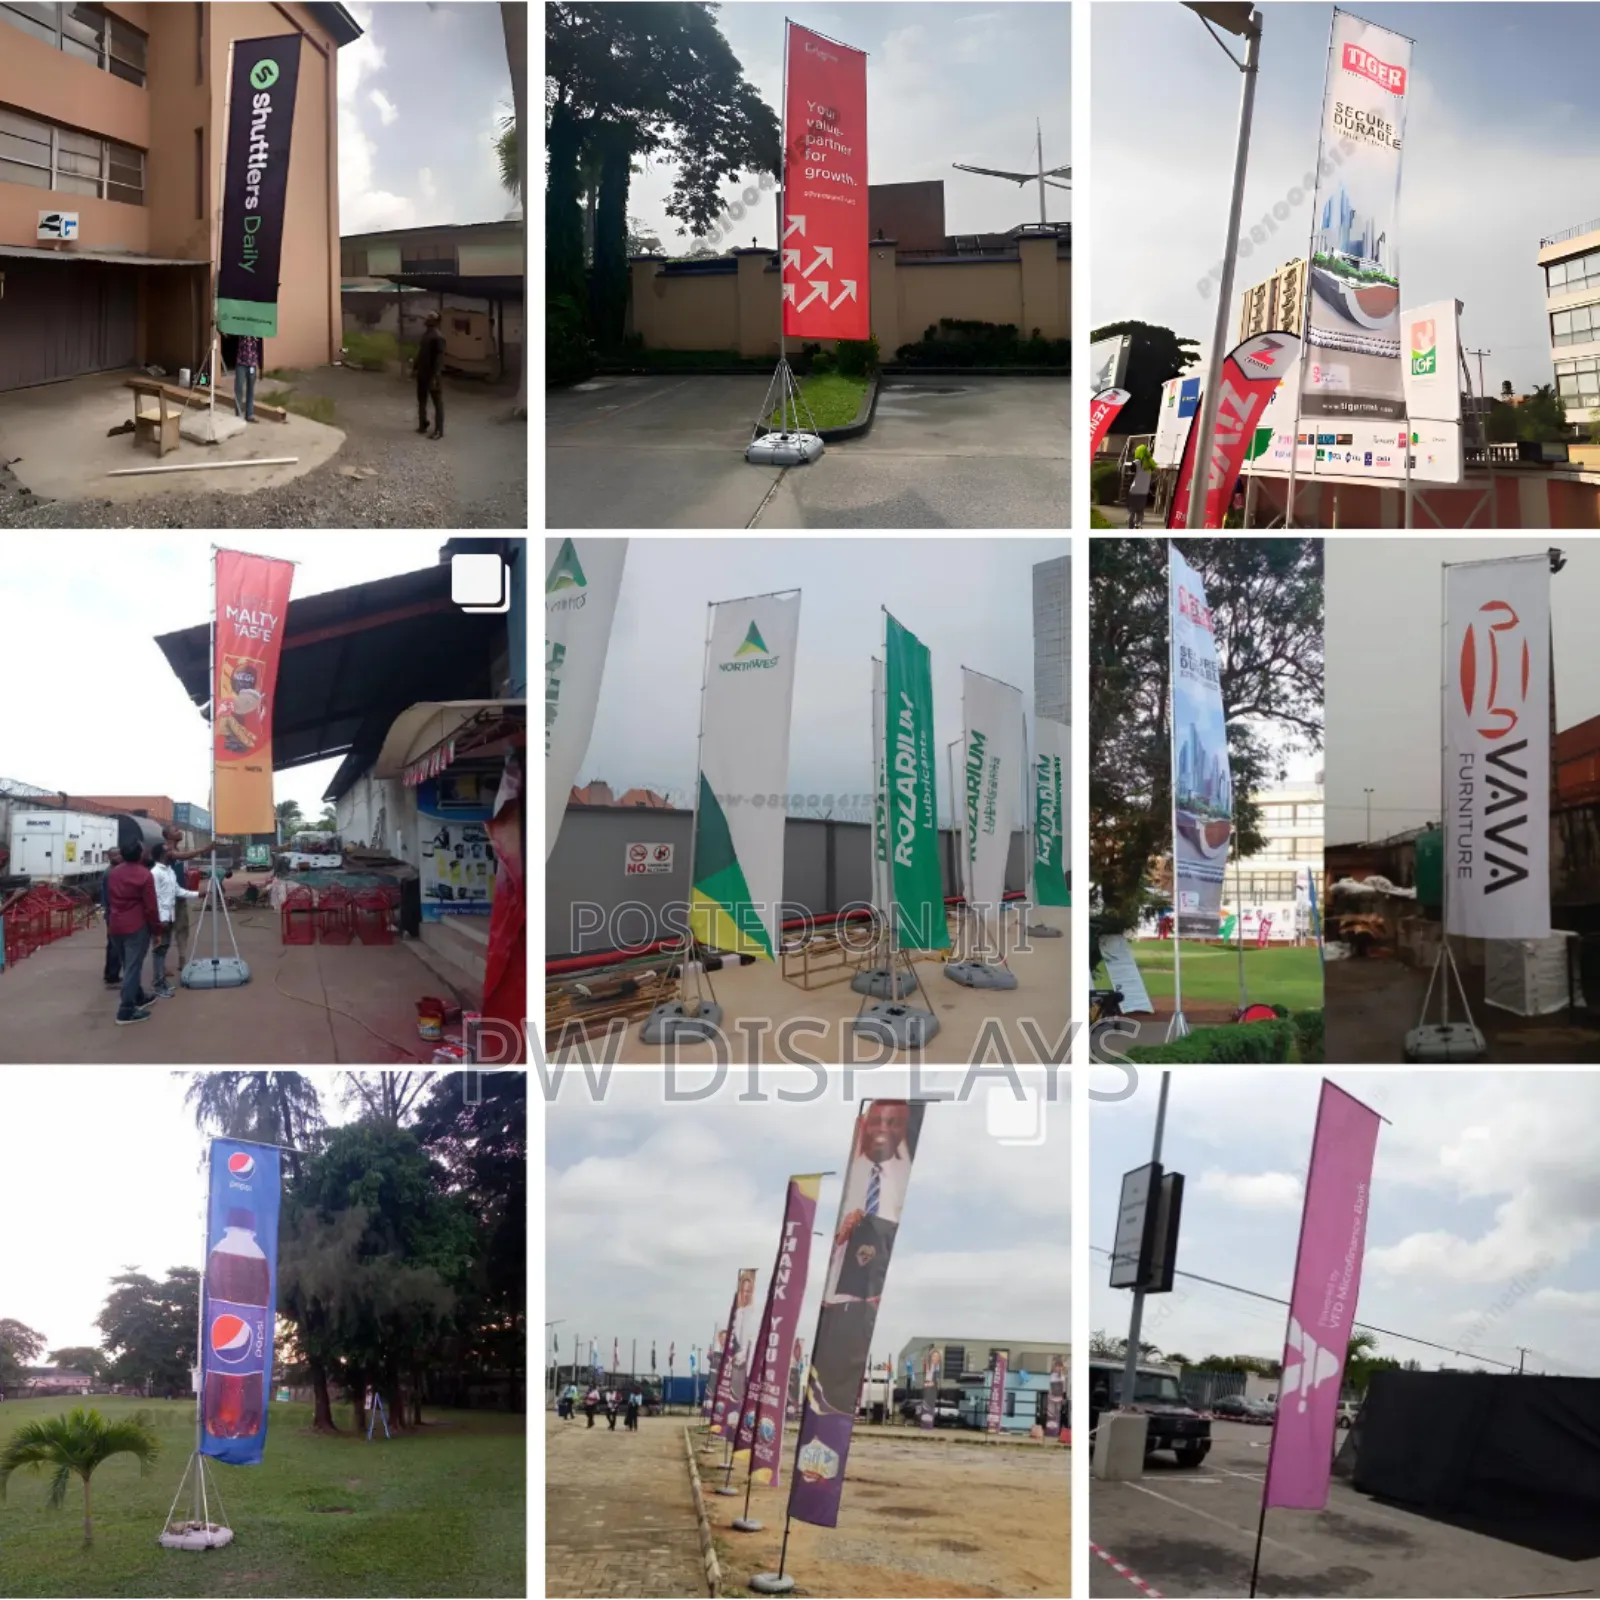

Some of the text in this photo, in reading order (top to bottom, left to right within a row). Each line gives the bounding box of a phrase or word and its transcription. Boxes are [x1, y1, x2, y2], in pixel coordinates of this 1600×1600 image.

[1347, 46, 1402, 87] TIGER
[806, 100, 835, 120] Your
[804, 147, 827, 161] for
[805, 134, 852, 156] partner
[238, 92, 273, 274] shuttlers Daily
[804, 166, 858, 187] growth.
[1412, 356, 1434, 374] IGF
[226, 605, 278, 631] MALTY
[233, 622, 272, 643] TASTE
[719, 656, 780, 672] NORTHWEST
[1457, 753, 1475, 879] FURNITURE
[1484, 738, 1529, 895] VAVA
[627, 863, 647, 873] NO
[1328, 1183, 1366, 1328] VFD Microfinance Bank
[765, 1221, 801, 1363] THANK YOU
[255, 1321, 264, 1358] pepsi
